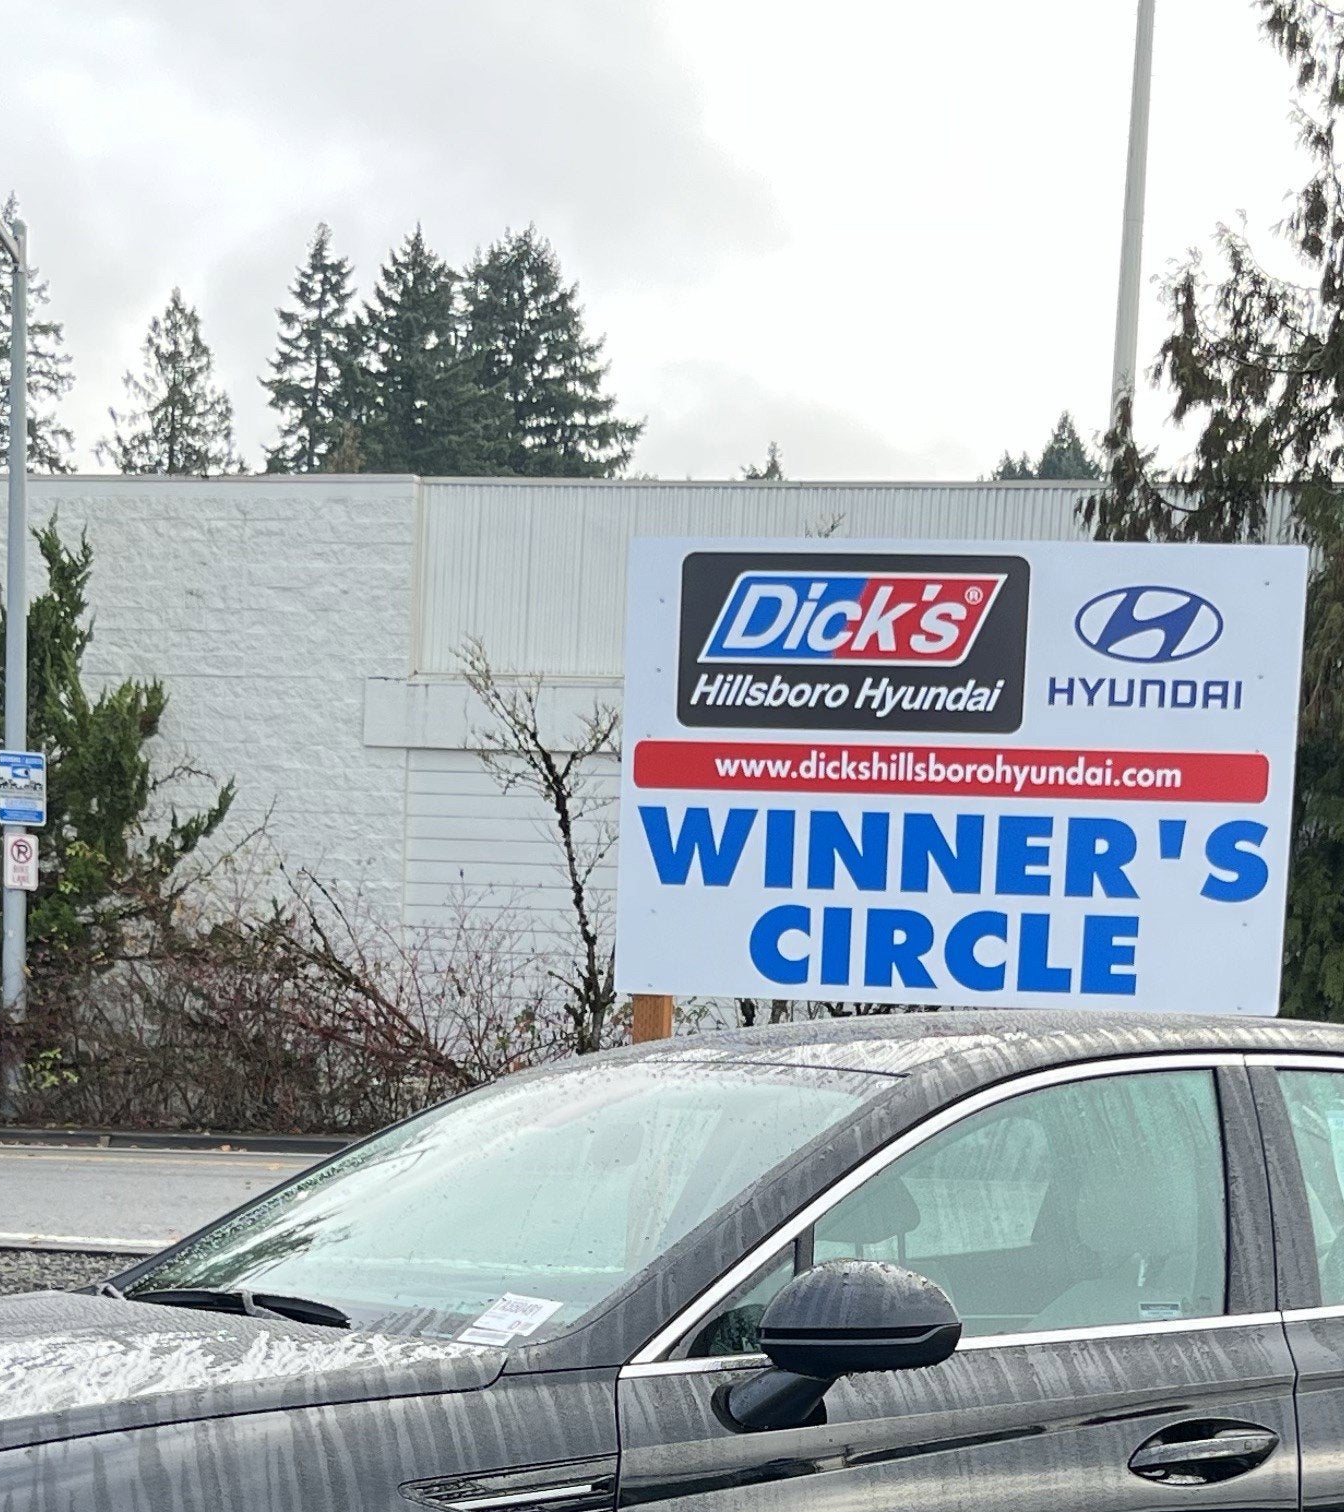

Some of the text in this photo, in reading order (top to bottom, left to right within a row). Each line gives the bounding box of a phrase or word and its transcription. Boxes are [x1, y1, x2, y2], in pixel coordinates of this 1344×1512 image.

[690, 673, 1005, 717] Hillsboro Hyundai
[1048, 677, 1242, 710] HYUNDAI
[715, 749, 1182, 791] www.dickshillsborohyundai.com
[638, 805, 1269, 903] WINNER'S
[748, 904, 1140, 996] CIRCLE
